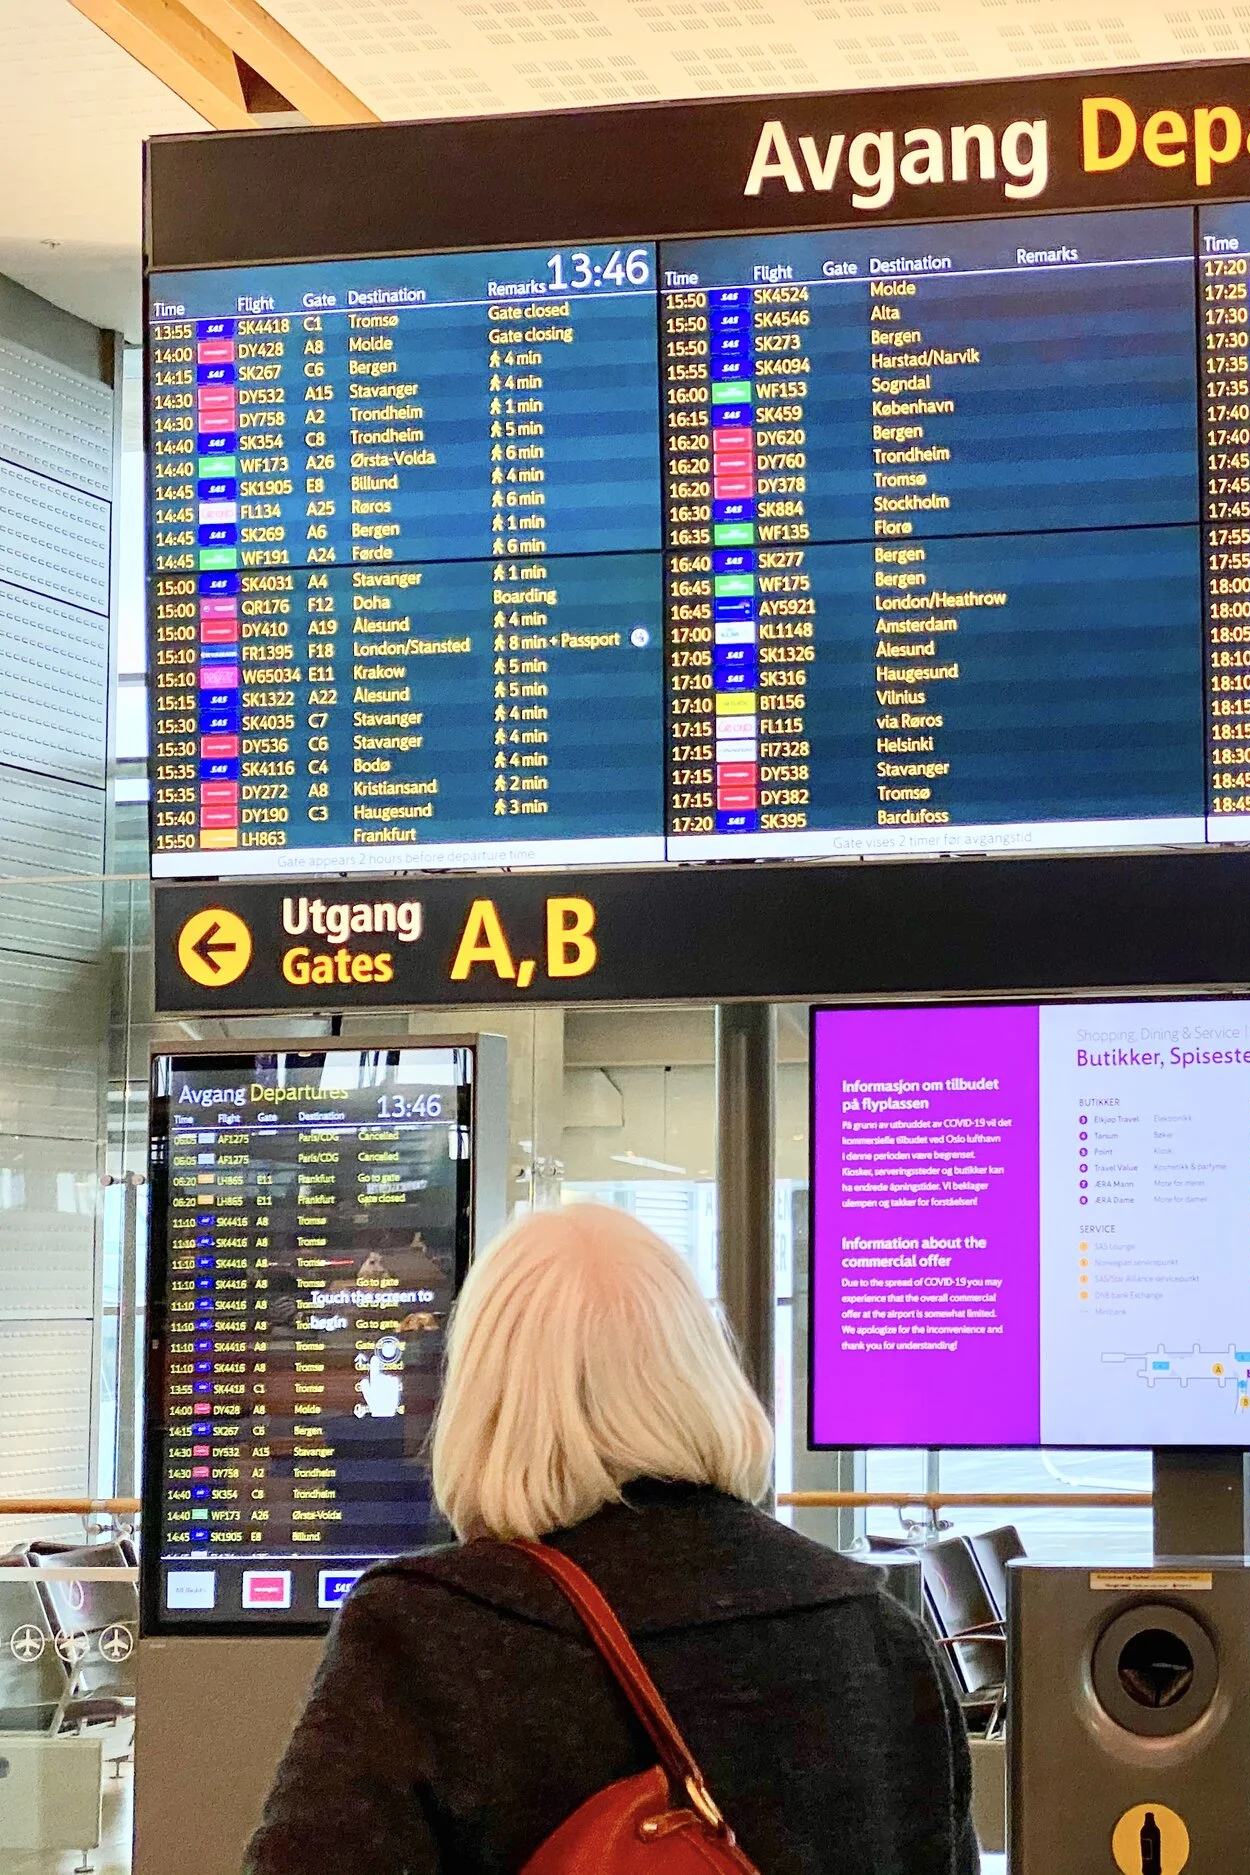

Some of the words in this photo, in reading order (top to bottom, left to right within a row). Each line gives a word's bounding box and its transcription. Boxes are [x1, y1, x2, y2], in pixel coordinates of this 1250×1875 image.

[744, 120, 1048, 209] Avgang
[548, 249, 649, 290] 13:46
[1205, 259, 1247, 276] 17:20
[153, 302, 185, 316] Time
[238, 296, 274, 313] Flight
[303, 293, 336, 307] Gate
[349, 288, 425, 305] Destination
[488, 280, 547, 296] Remarks
[155, 324, 192, 340] 13:55
[238, 318, 289, 335] SK4418
[304, 316, 322, 331] C1
[348, 314, 399, 328] Tromsø
[488, 306, 523, 320] Gate
[524, 302, 569, 318] closed
[155, 348, 192, 363] 14:00
[239, 342, 284, 358] DY428
[304, 340, 324, 354] A8
[350, 336, 393, 351] Molde
[489, 329, 523, 343] Gate
[525, 326, 573, 343] closing
[1207, 332, 1248, 349] 17:30
[668, 364, 707, 380] 15:55
[756, 358, 810, 375] SK4094
[872, 348, 980, 369] Harstad/Narvik
[1207, 356, 1248, 373] 17:35
[669, 411, 709, 427] 16:15
[756, 406, 802, 422] SK459
[873, 399, 954, 416] København
[156, 462, 194, 478] 14:40
[240, 457, 288, 473] WF173
[306, 455, 334, 469] A26
[351, 450, 436, 468] Ørsta-Volda
[506, 445, 517, 460] 6
[519, 445, 544, 459] min
[157, 603, 196, 619] 15:00
[242, 599, 290, 615] QR176
[309, 597, 333, 612] F12
[354, 595, 390, 610] Doha
[494, 588, 557, 605] Boarding
[671, 604, 711, 620] 16:45
[759, 599, 815, 616] AY5921
[876, 591, 1006, 610] London/Heathrow
[157, 649, 195, 664] 15:10
[243, 645, 293, 660] FR1395
[309, 644, 334, 658] F18
[354, 638, 470, 656] London/Stansted
[509, 636, 520, 650] 8
[522, 635, 548, 649] min
[561, 633, 620, 649] Passport
[157, 672, 195, 687] 15:10
[243, 668, 301, 684] W65034
[309, 666, 334, 681] E11
[354, 665, 405, 679] Krakow
[510, 659, 519, 673] 5
[522, 658, 547, 673] min
[672, 698, 712, 714] 17:10
[761, 694, 805, 710] BT156
[876, 690, 926, 705] Vilnius
[673, 745, 712, 761] 17:15
[761, 742, 809, 757] FI7328
[877, 737, 933, 753] Helsinki
[157, 834, 195, 849] 15:50
[242, 831, 286, 846] LH863
[354, 827, 416, 843] Frankfurt
[833, 837, 863, 849] Gate
[866, 837, 896, 849] vises
[899, 836, 907, 847] 2
[909, 834, 941, 847] timer
[944, 833, 960, 846] før
[964, 831, 1032, 848] avgangstid
[283, 898, 421, 943] Utgang
[451, 898, 596, 987] A,B
[283, 948, 393, 984] Gates
[1078, 1049, 1164, 1066] Butikker,
[179, 1085, 247, 1107] Avgang
[251, 1081, 351, 1104] Departures
[843, 1080, 920, 1094] Informasjon
[922, 1082, 943, 1091] om
[945, 1078, 999, 1090] tilbudet
[377, 1091, 444, 1117] 13:46
[843, 1098, 860, 1113] på
[862, 1097, 929, 1112] flyplassen
[1080, 1098, 1119, 1107] BUTIKKER
[1080, 1225, 1115, 1233] SERVICE
[842, 1237, 919, 1249] Information
[922, 1237, 961, 1249] about
[964, 1236, 986, 1248] the
[842, 1255, 917, 1267] commercial
[919, 1254, 951, 1267] offer
